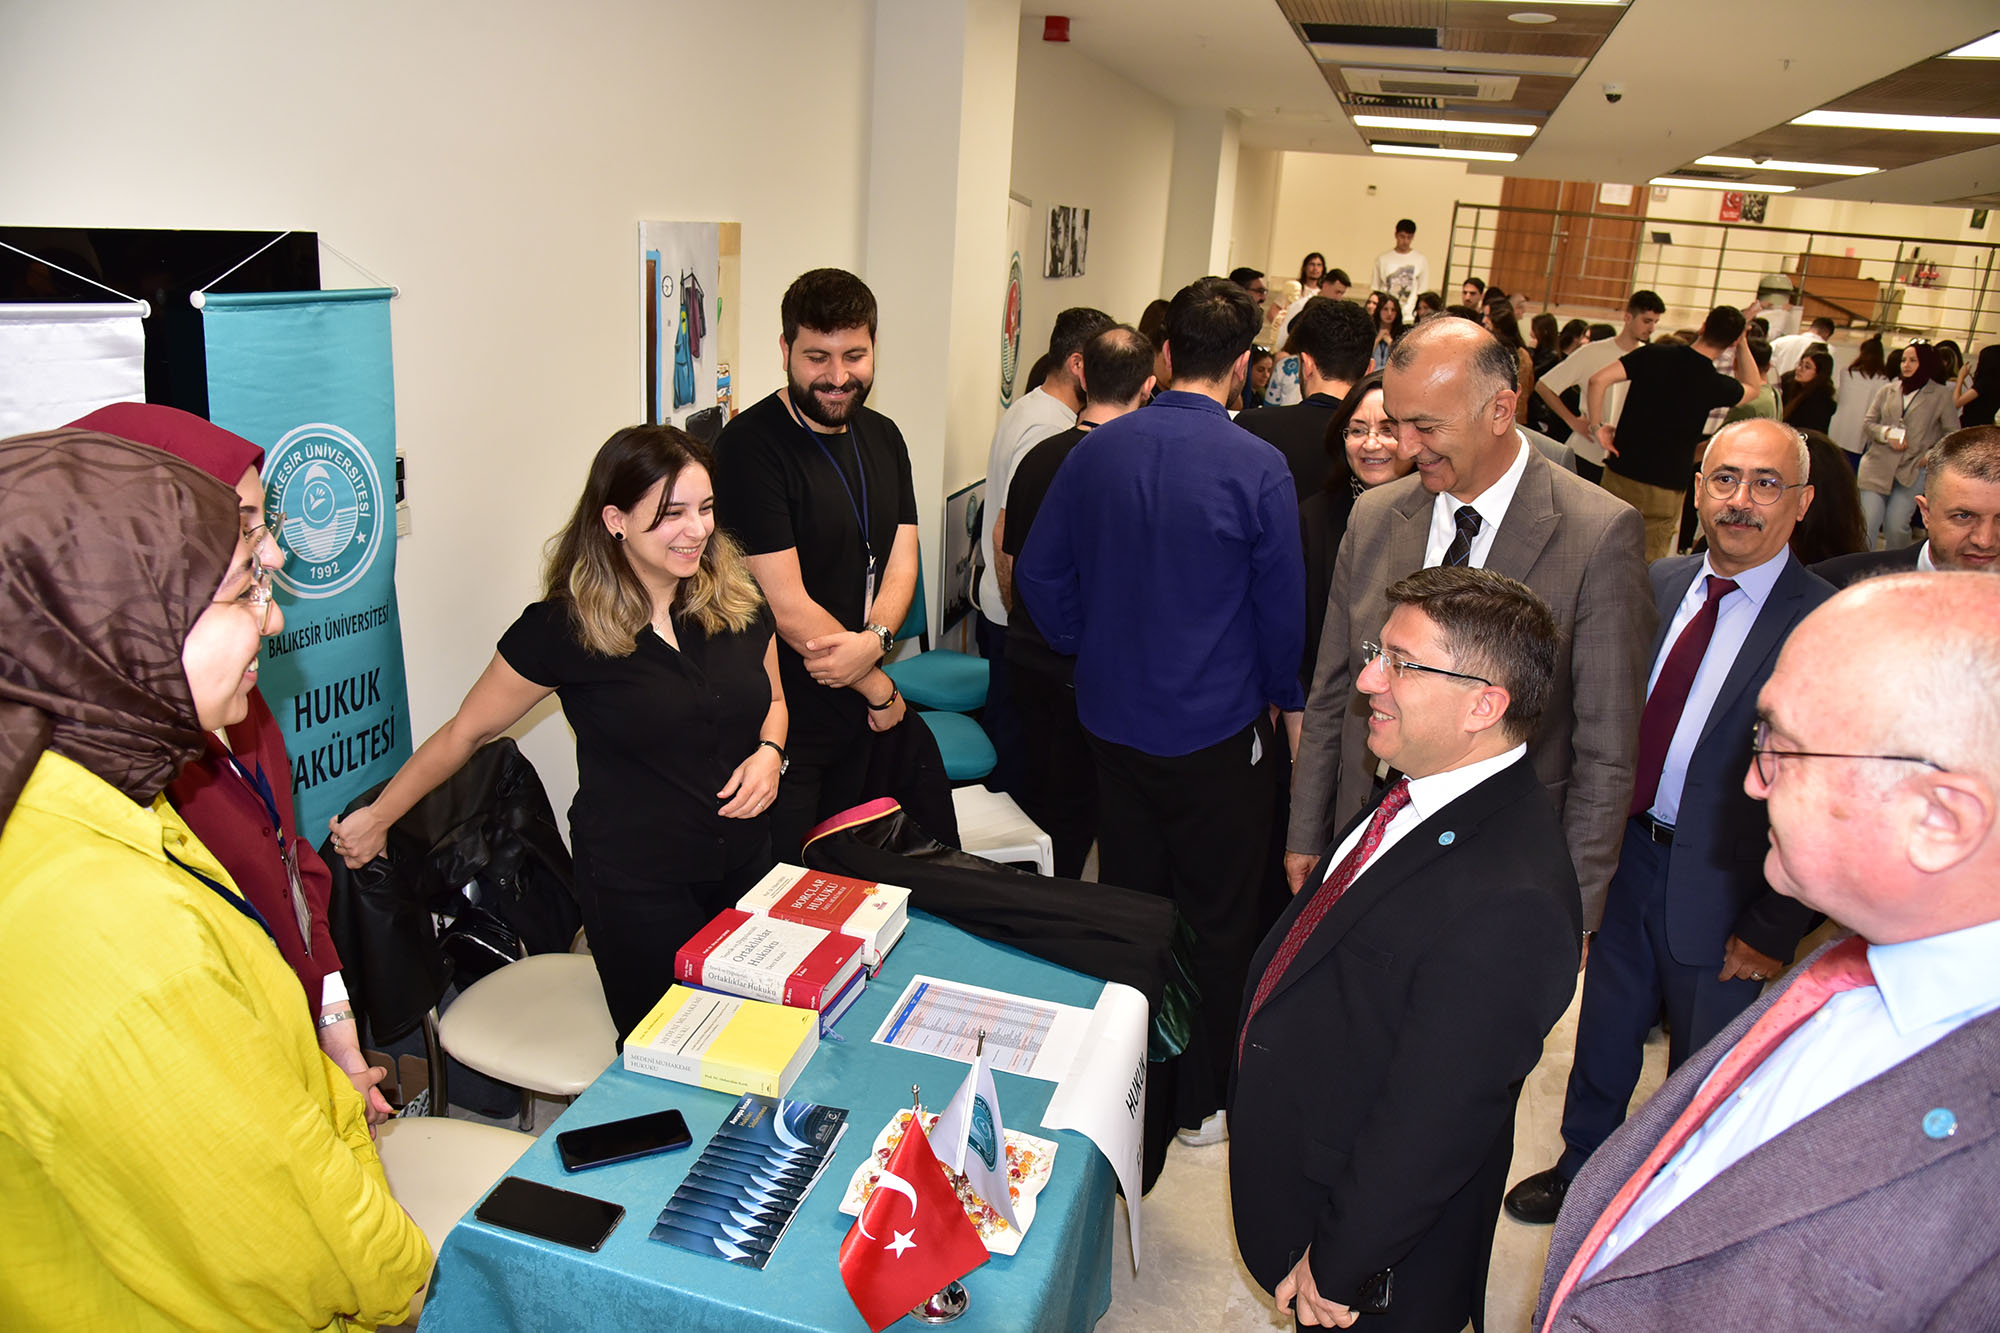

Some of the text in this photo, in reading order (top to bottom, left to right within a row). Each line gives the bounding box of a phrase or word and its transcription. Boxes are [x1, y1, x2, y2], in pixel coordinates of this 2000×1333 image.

[269, 443, 371, 522] ALIKESİR ÜNİVERSİTESİ
[310, 561, 340, 579] 1992
[268, 599, 389, 659] BALIKESİR ÜNİVERSİTESİ
[294, 667, 381, 733] HUKUK
[289, 705, 395, 796] AKÜLTESİ
[791, 879, 827, 909] BORÇLAR
[806, 883, 839, 911] HUKUKU
[733, 929, 772, 962] Ortaklıklar
[747, 941, 779, 966] Hukuku
[708, 972, 776, 996] Ortaklıklar Hukuku
[659, 1022, 679, 1045] MEDENİ
[630, 1054, 691, 1072] MEDENİ MUHAKEME
[630, 1062, 659, 1072] HUKUKU
[1125, 1050, 1146, 1120] HUKUK
